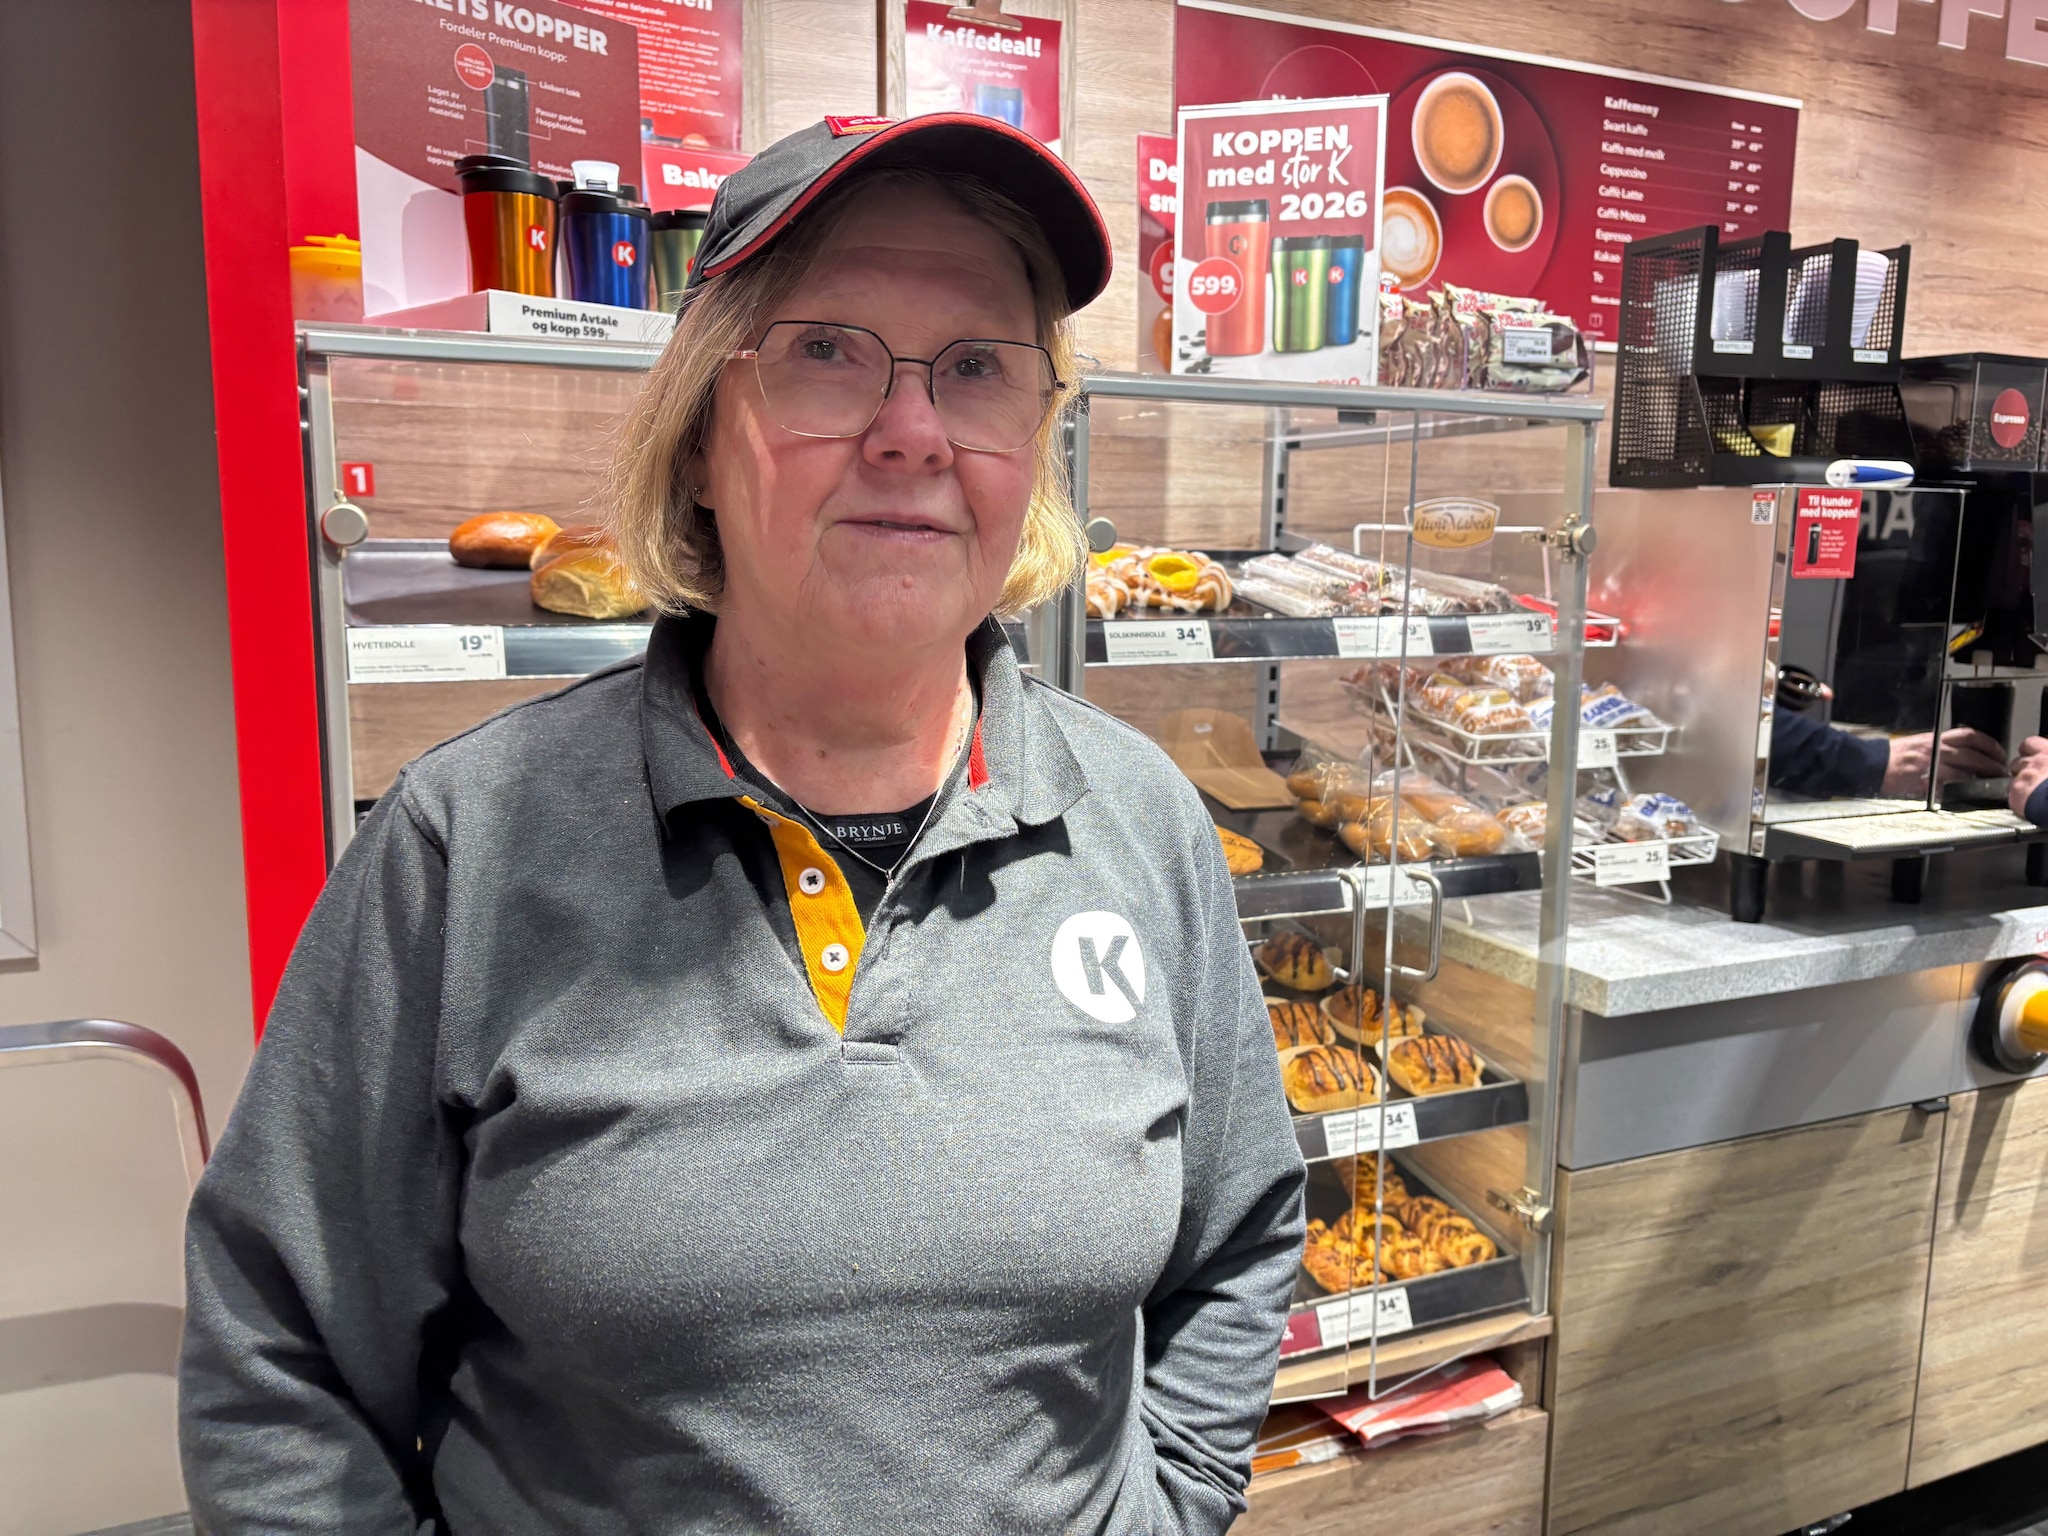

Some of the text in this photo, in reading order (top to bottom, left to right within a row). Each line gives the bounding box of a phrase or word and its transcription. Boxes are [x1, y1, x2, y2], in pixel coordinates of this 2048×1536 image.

[494, 1, 608, 56] KOPPER
[440, 18, 567, 63] Fordeler Premium kopp:
[927, 23, 1041, 58] Kaffedeal!
[1604, 96, 1659, 118] Kaffemeny
[1603, 119, 1627, 133] Svart
[1627, 123, 1648, 136] kaffe
[1212, 125, 1348, 157] KOPPEN
[1207, 145, 1353, 189] med stor K
[1600, 163, 1647, 180] Cappuccino
[1621, 188, 1644, 201] Latte
[1279, 191, 1367, 221] 2026
[1595, 228, 1632, 243] Espresso
[1594, 250, 1621, 263] Kakao
[522, 304, 618, 327] Premium Avtale
[532, 322, 547, 333] og
[550, 322, 580, 337] kopp
[1994, 413, 2025, 424] Espresso
[351, 467, 367, 493] 1
[1808, 495, 1853, 507] Til kunder
[1800, 507, 1858, 520] med koppen!
[1108, 631, 1166, 639] SOLSKINNSBOLLE
[353, 641, 416, 649] HVETEBOLLE
[836, 822, 903, 838] BRYNJE
